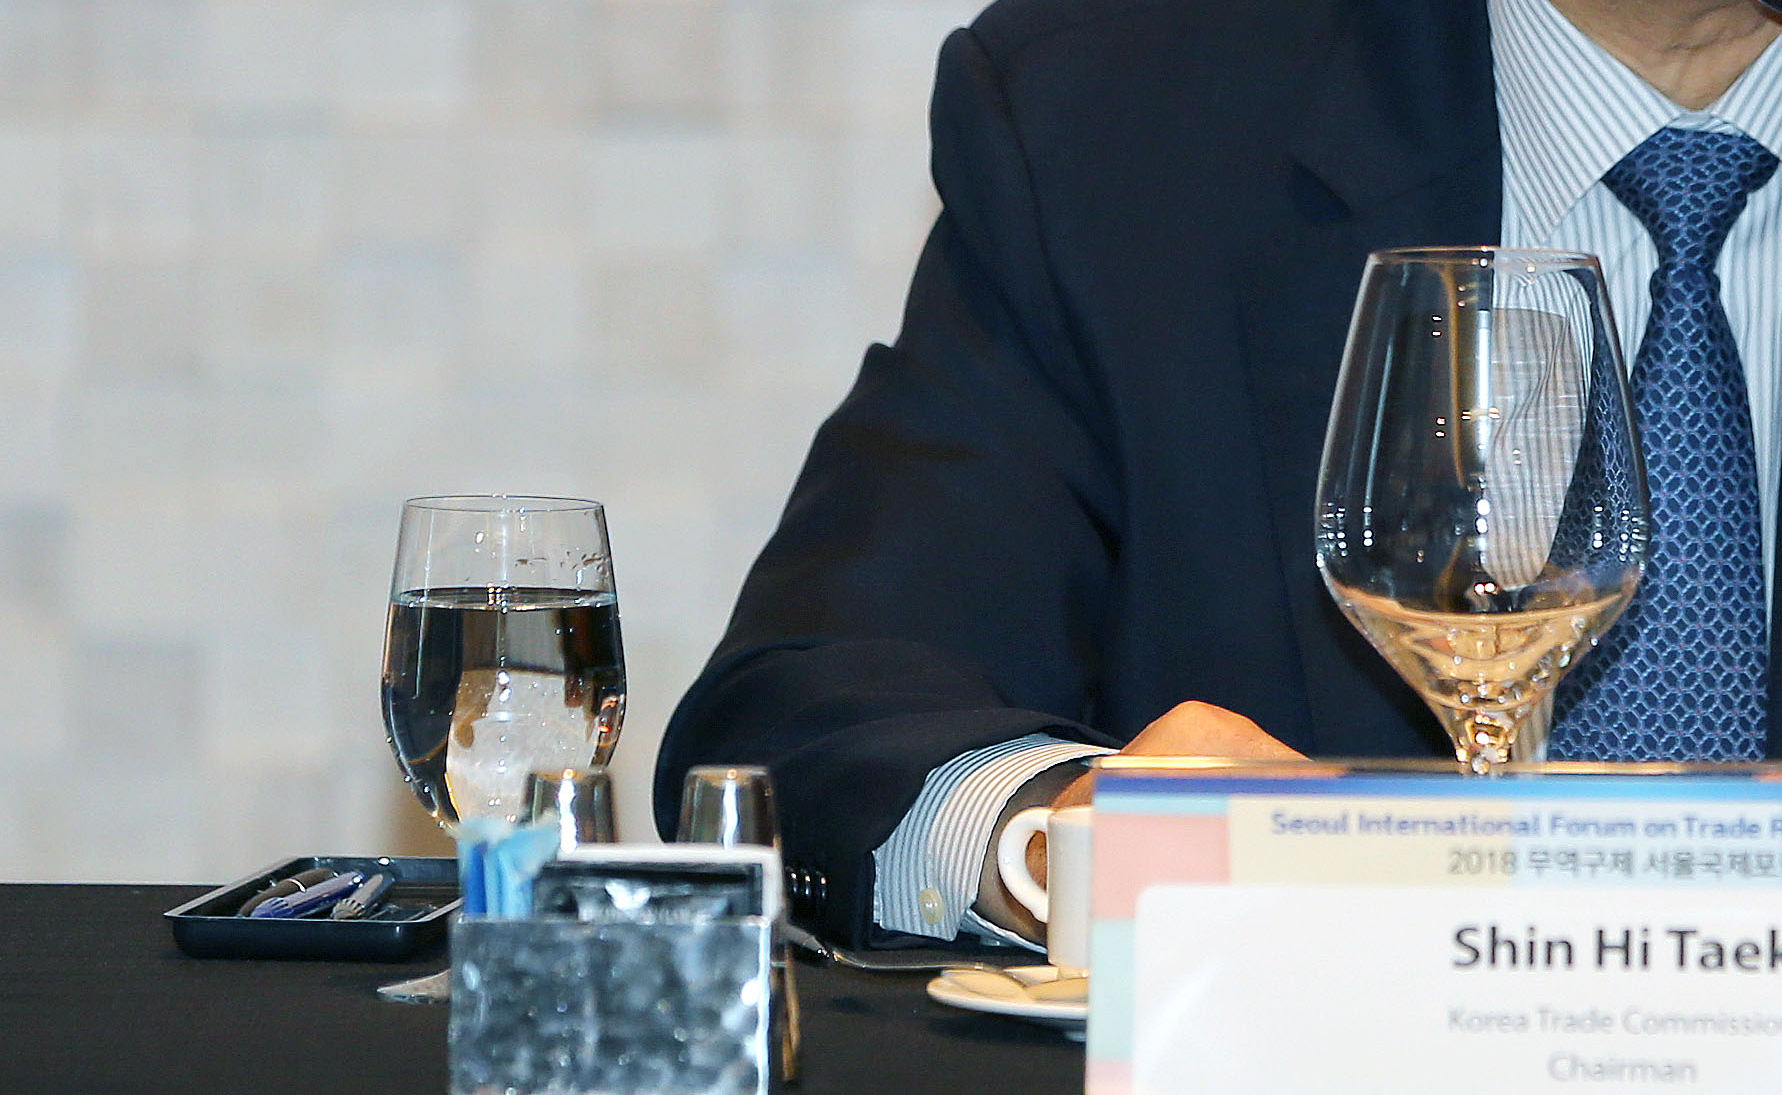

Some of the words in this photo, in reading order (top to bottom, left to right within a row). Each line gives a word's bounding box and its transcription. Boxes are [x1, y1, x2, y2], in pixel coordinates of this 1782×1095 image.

[1271, 812, 1347, 836] Seoul
[1358, 813, 1541, 837] International
[1551, 815, 1635, 837] Forum
[1645, 820, 1677, 838] on
[1684, 816, 1761, 838] Trade
[1449, 849, 1517, 875] 2018
[1527, 848, 1634, 877] 무역구제
[1453, 925, 1575, 970] Shin
[1594, 927, 1651, 970] Hi
[1449, 1007, 1530, 1034] Korea
[1538, 1006, 1614, 1034] Trade
[1548, 1052, 1698, 1083] Chairman
